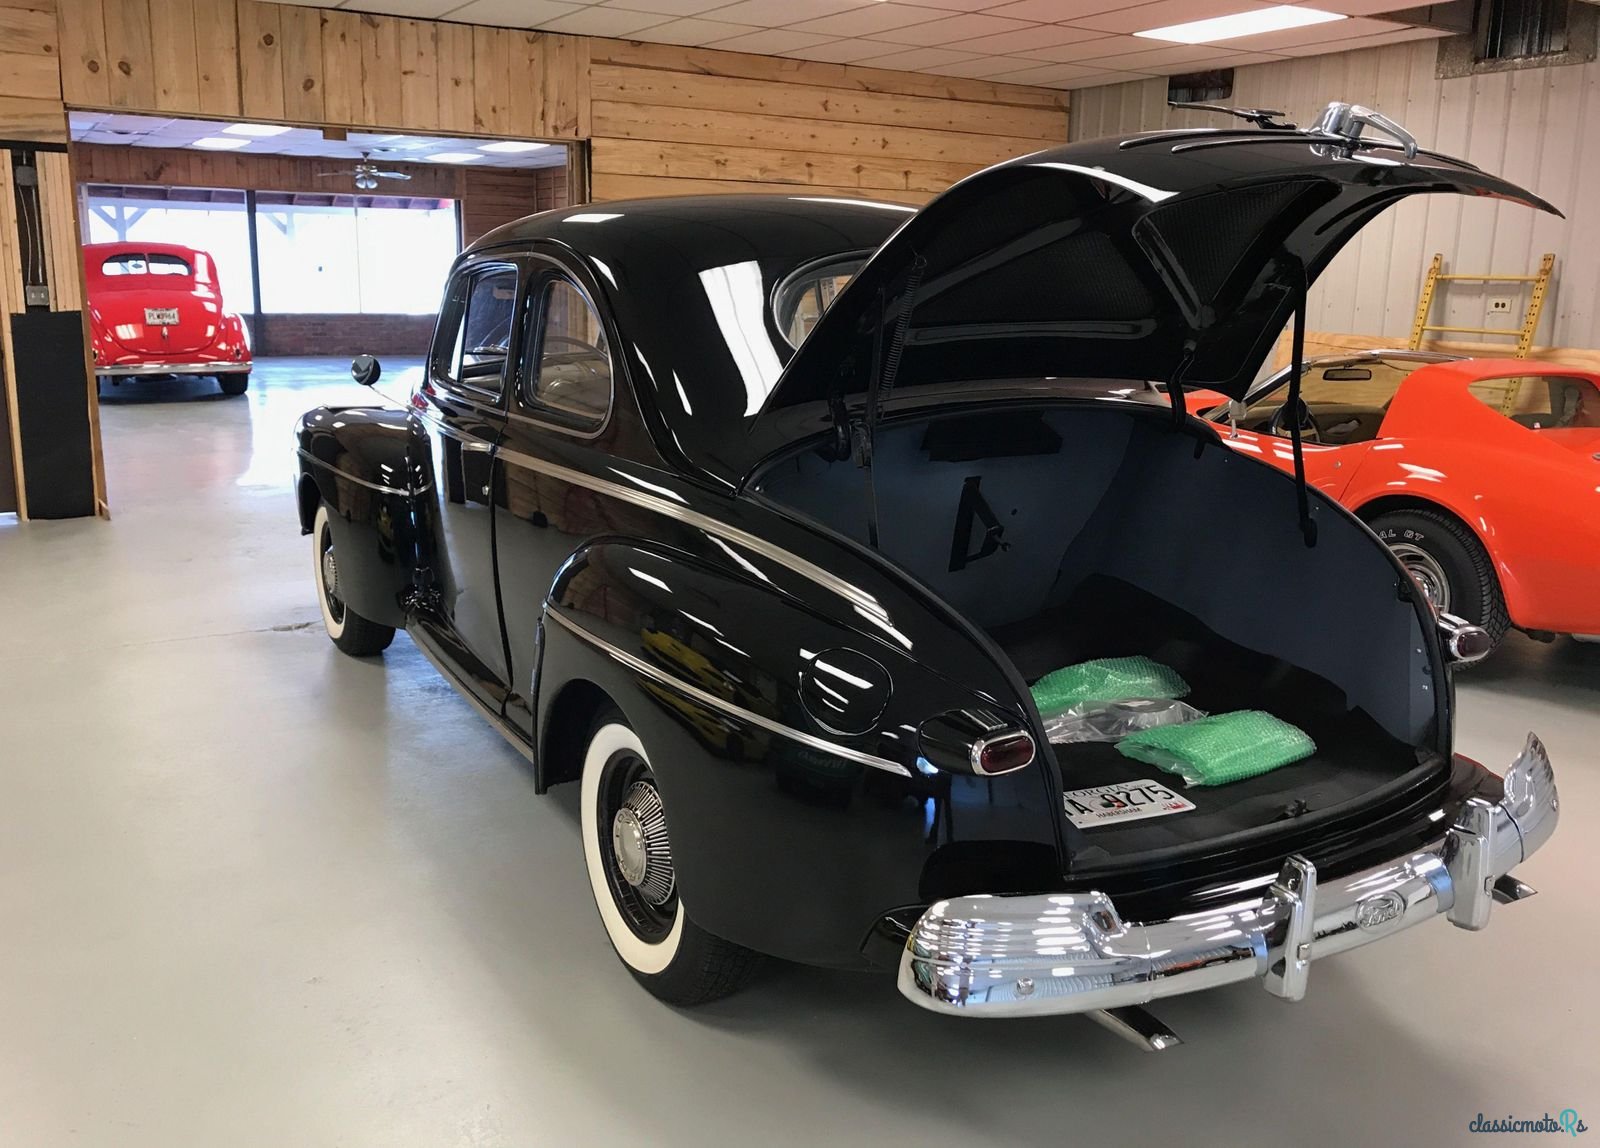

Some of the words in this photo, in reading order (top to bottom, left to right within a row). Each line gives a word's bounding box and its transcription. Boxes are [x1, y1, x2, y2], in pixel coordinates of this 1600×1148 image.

[1403, 529, 1425, 541] GT
[1063, 784, 1127, 799] EORGIA
[1064, 798, 1094, 816] A
